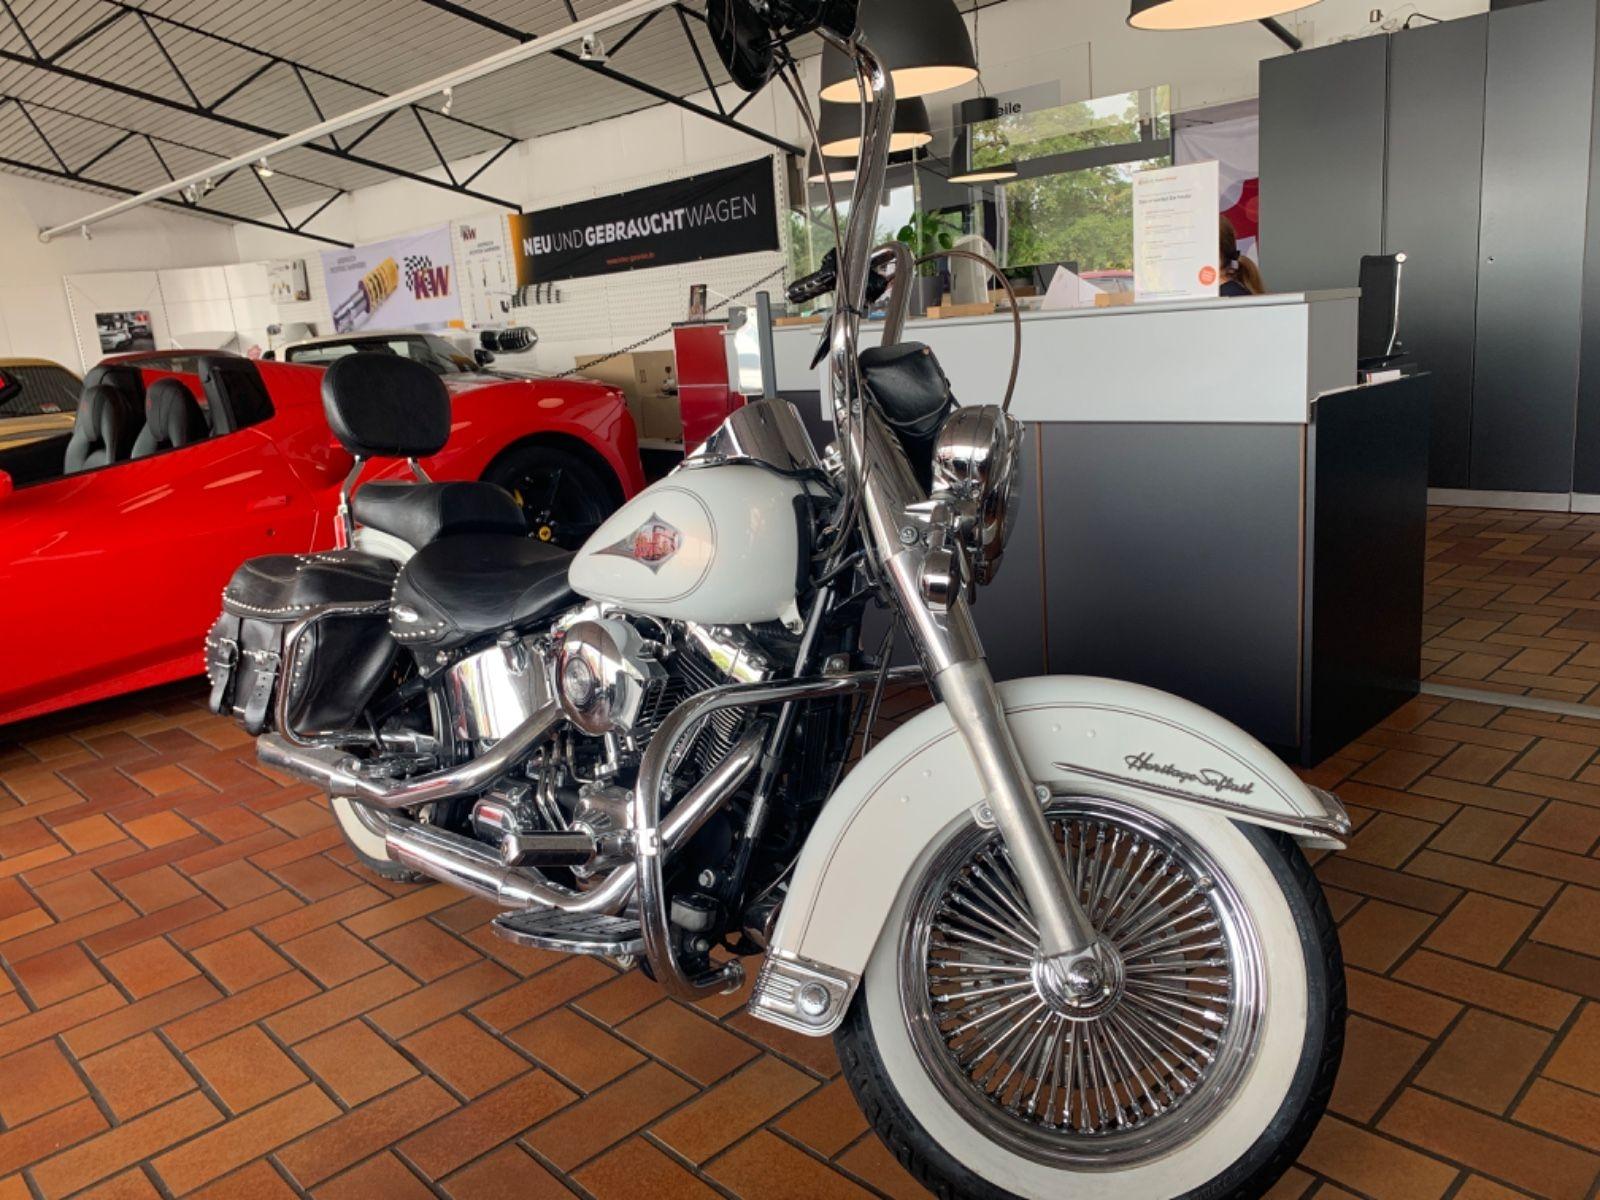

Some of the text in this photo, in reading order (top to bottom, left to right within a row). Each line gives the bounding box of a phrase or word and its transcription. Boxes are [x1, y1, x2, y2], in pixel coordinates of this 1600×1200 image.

[997, 102, 1022, 116] eile
[412, 265, 450, 300] KW
[1124, 751, 1255, 795] Heritage Softail
